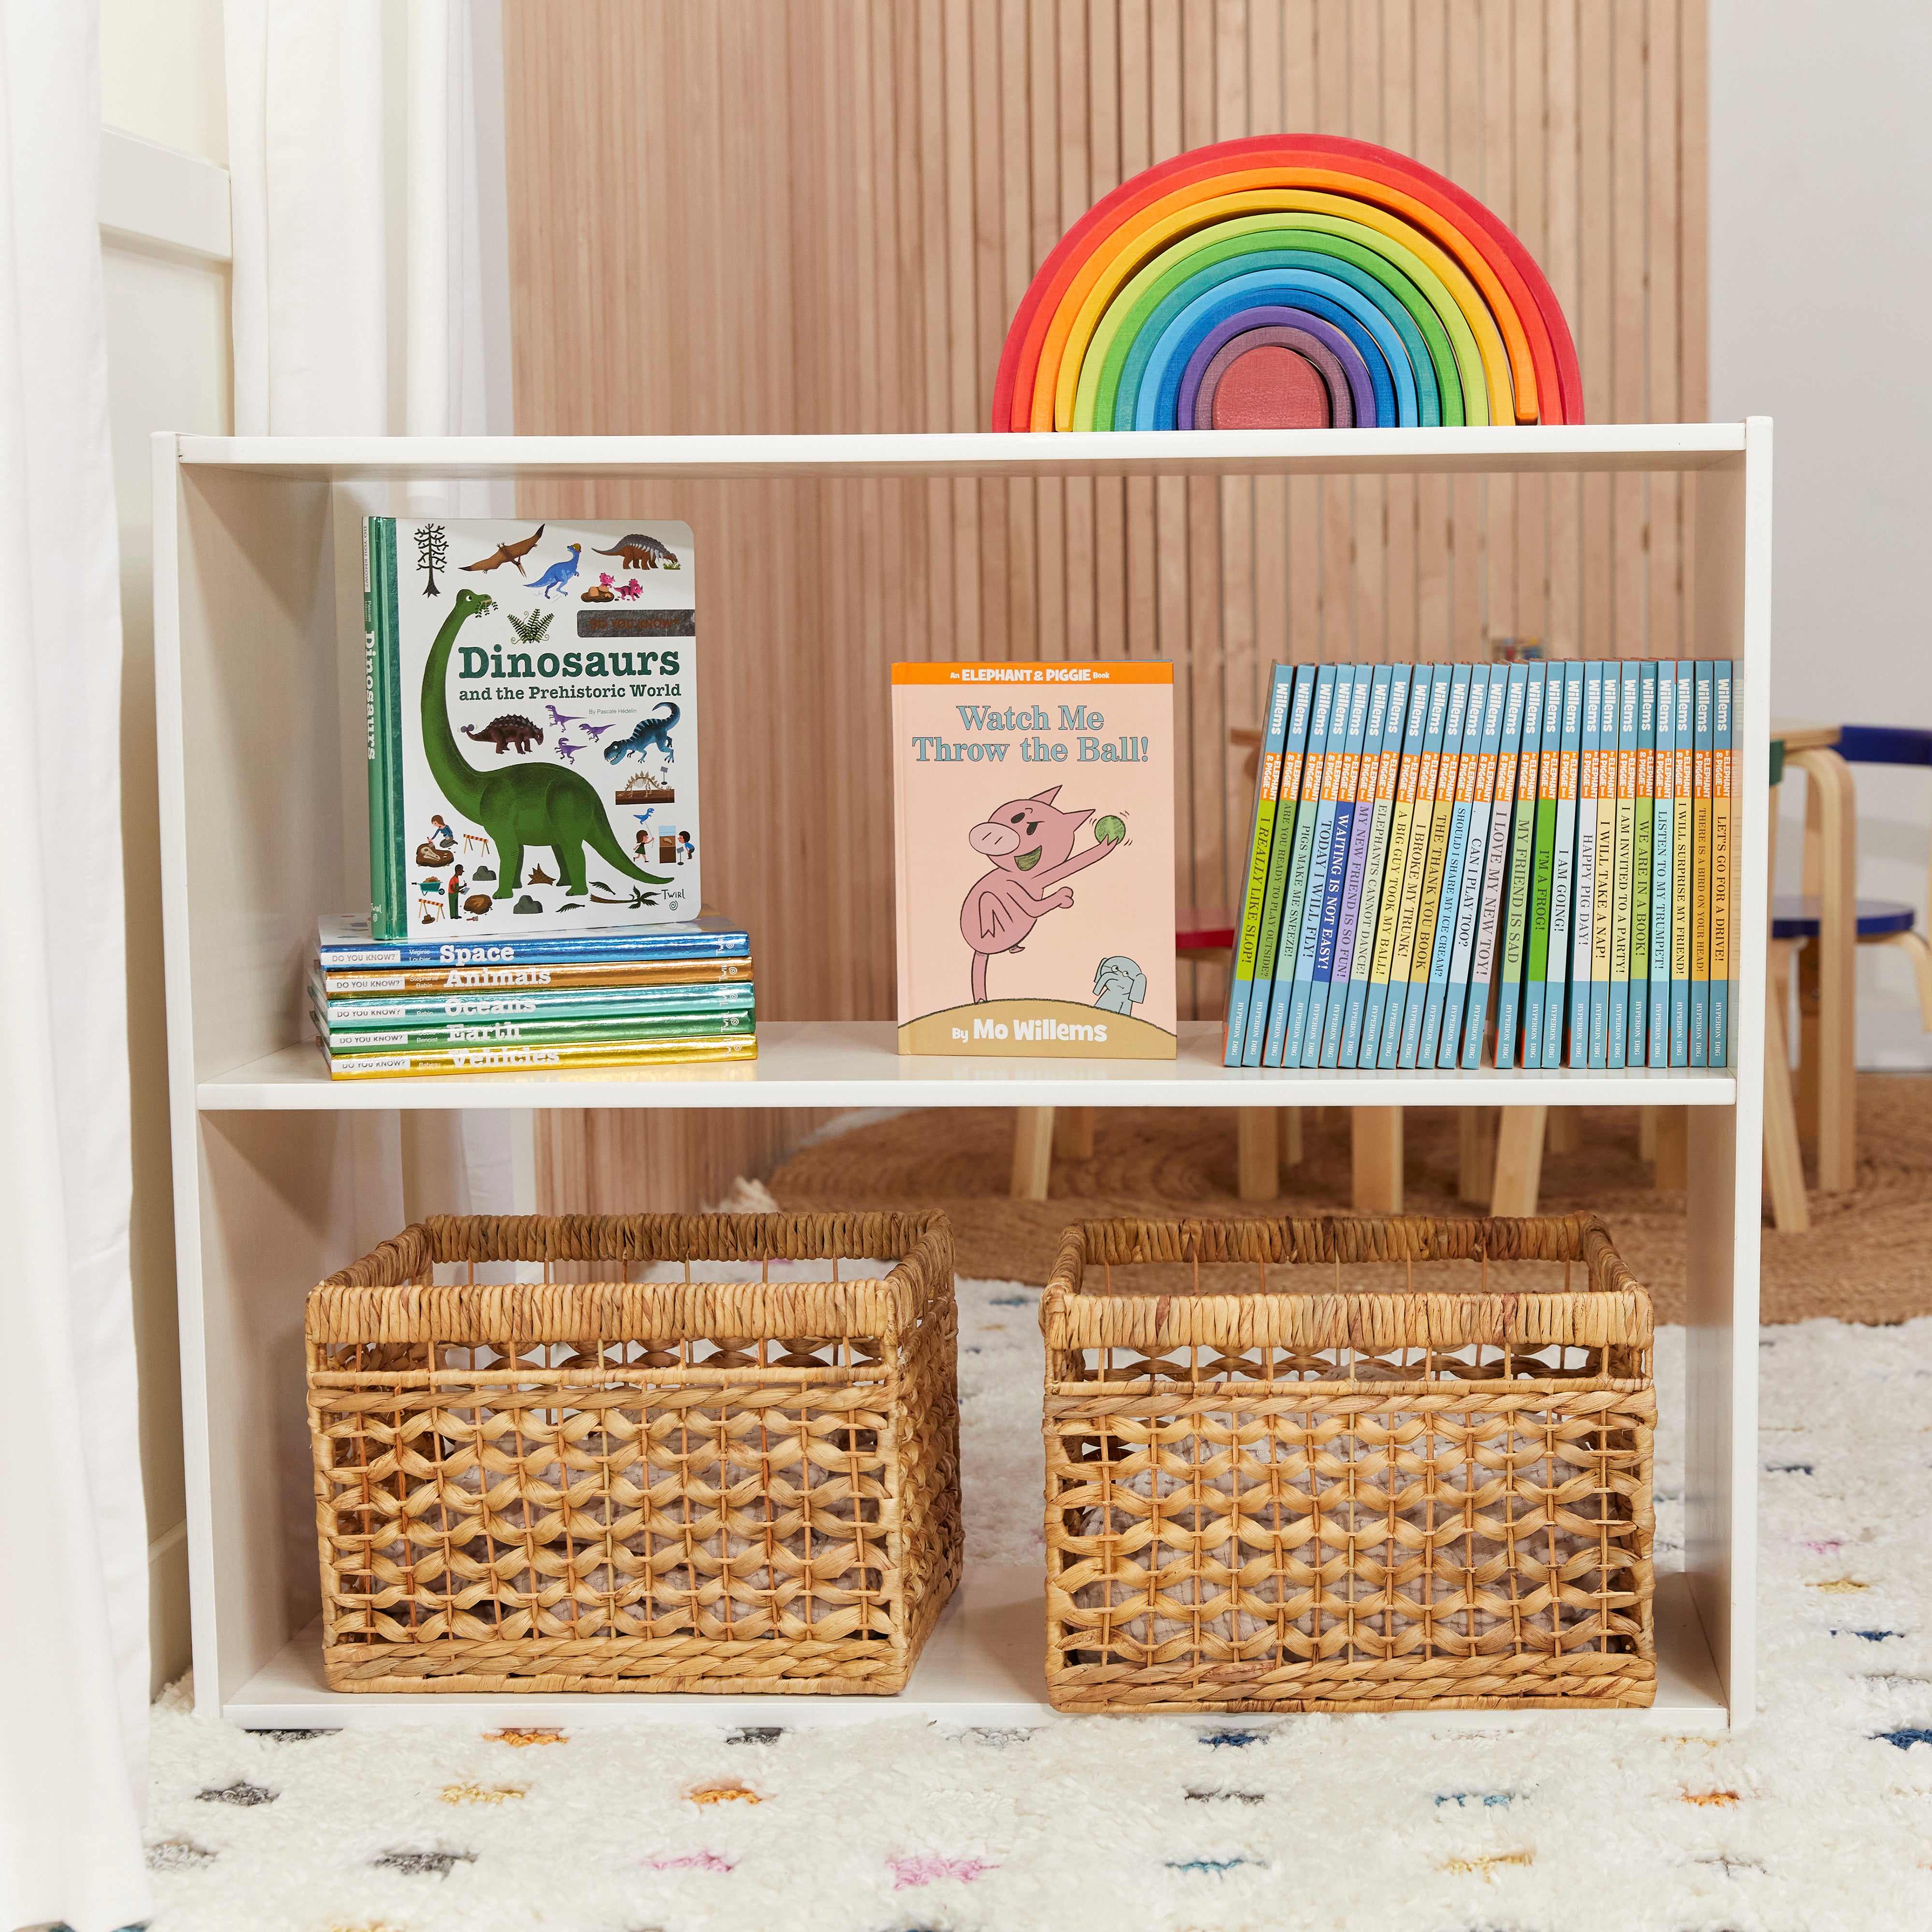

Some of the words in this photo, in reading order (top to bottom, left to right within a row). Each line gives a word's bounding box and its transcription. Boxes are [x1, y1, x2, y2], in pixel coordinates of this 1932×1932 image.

[364, 526, 367, 538] DO
[590, 620, 608, 629] DO
[611, 619, 634, 628] YOU
[637, 619, 679, 628] KNOW?
[458, 644, 680, 678] Dinosaurs
[962, 669, 1033, 682] ELEPHANT
[1034, 672, 1043, 681] &
[1046, 668, 1091, 682] PIGGIE
[366, 631, 376, 760] Dinosaurs
[459, 687, 492, 701] and
[496, 687, 525, 700] the
[528, 685, 626, 699] Prehistoric
[630, 684, 682, 697] World
[1587, 680, 1600, 732] Willems
[1718, 679, 1730, 731] Willems
[956, 705, 1051, 730] Watch
[1058, 705, 1104, 730] Me
[1272, 683, 1289, 735] Willems
[1350, 684, 1367, 736] Willems
[1466, 684, 1484, 736] Willems
[912, 737, 1010, 762] Throw
[1020, 737, 1068, 762] the
[1077, 736, 1149, 762] Ball!
[1281, 803, 1292, 824] ARE
[1398, 810, 1408, 819] A
[1620, 815, 1630, 834] AM
[1698, 808, 1706, 843] THERE
[1279, 826, 1289, 848] YOU
[1299, 825, 1311, 851] PIGS
[1369, 804, 1388, 876] ELEPHANTS
[1394, 823, 1406, 845] BIG
[1433, 814, 1447, 843] THE
[1490, 822, 1506, 864] LOVE
[1638, 820, 1649, 843] WE
[1657, 811, 1667, 856] LISTEN
[1716, 816, 1727, 852] LET'S
[1252, 826, 1270, 885] REALLY
[1315, 820, 1332, 869] TODAY
[1330, 814, 1350, 876] WAITING
[1468, 838, 1482, 866] CAN
[1581, 835, 1593, 881] HAPPY
[1698, 845, 1706, 855] IS
[1274, 849, 1286, 884] READY
[1293, 853, 1307, 887] MAKE
[1390, 848, 1403, 874] GUY
[1425, 847, 1443, 895] THANK
[1538, 849, 1550, 871] I'M
[1618, 838, 1630, 891] INVITED
[1637, 847, 1648, 877] ARE
[1656, 860, 1666, 878] TO
[1716, 855, 1726, 873] GO
[1271, 885, 1281, 900] TO
[1328, 878, 1340, 893] IS
[1486, 868, 1500, 893] MY
[1537, 874, 1548, 884] A
[1636, 881, 1648, 895] IN
[1656, 881, 1666, 900] MY
[1697, 867, 1705, 892] BIRD
[1715, 876, 1726, 902] FOR
[1247, 887, 1261, 921] LIKE
[1291, 889, 1302, 907] ME
[1307, 883, 1324, 922] WILL
[1362, 879, 1377, 928] CANNOT
[1384, 877, 1399, 912] TOOK
[1463, 877, 1477, 911] PLAY
[1579, 885, 1591, 909] PIG
[1618, 894, 1628, 911] TO
[1636, 899, 1647, 909] A
[1697, 895, 1705, 909] ON
[1267, 901, 1279, 928] PLAY
[1323, 895, 1338, 925] NOT
[1421, 900, 1435, 928] YOU
[1481, 896, 1497, 935] NEW
[1534, 887, 1548, 931] FROG!
[1617, 914, 1627, 923] A
[1715, 905, 1725, 914] A
[1283, 909, 1299, 957] SNEEZE!
[1381, 915, 1393, 935] MY
[1458, 914, 1472, 948] TOO?
[1578, 913, 1590, 946] DAY!
[1634, 913, 1647, 956] BOOK!
[1654, 903, 1665, 969] TRUMPET!
[1696, 911, 1705, 938] YOUR
[1241, 924, 1256, 964] SLOP!
[1260, 929, 1275, 978] OUTSIDE?
[1302, 926, 1318, 958] FLY!
[1317, 927, 1334, 970] EASY!
[1355, 931, 1370, 975] DANCE!
[1415, 931, 1431, 970] BOOK
[1615, 927, 1626, 973] PARTY!
[1714, 918, 1725, 962] DRIVE!
[440, 945, 514, 966] Space
[1375, 938, 1390, 975] BALL!
[1476, 938, 1492, 976] TOY!
[1696, 941, 1705, 972] HEAD!
[443, 967, 551, 987] Animals
[444, 998, 536, 1016] Oceans
[447, 1022, 522, 1042] Earth
[952, 1027, 968, 1043] By
[974, 1019, 1009, 1039] Mo
[1013, 1019, 1108, 1042] Willems
[449, 1047, 559, 1068] Vehicles
